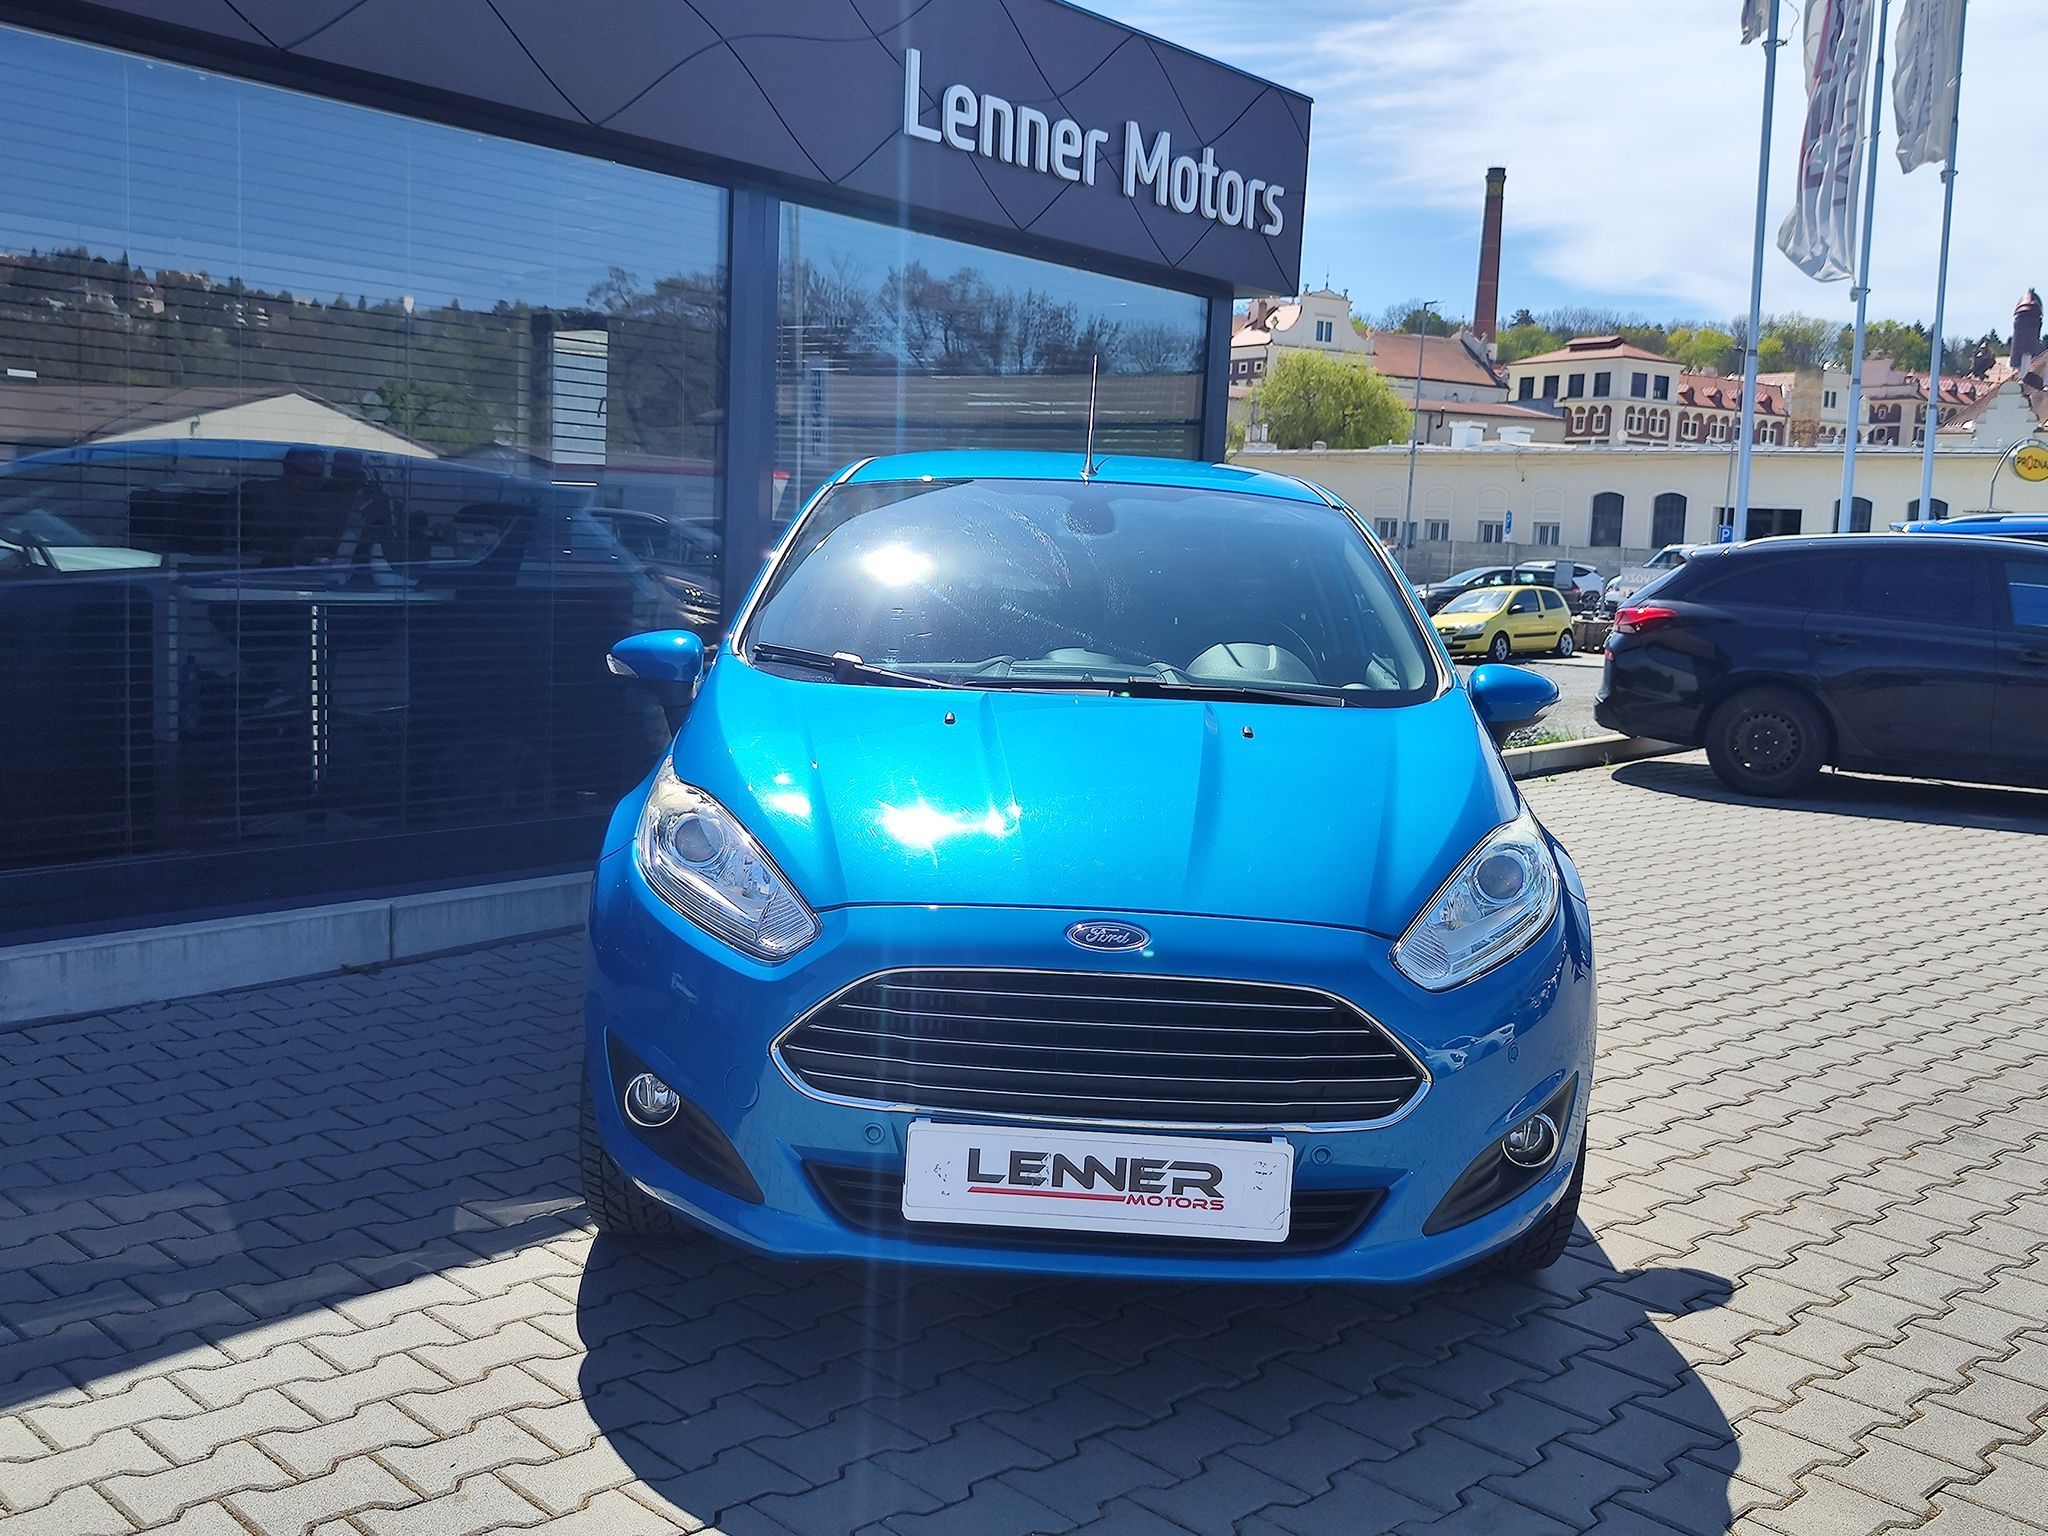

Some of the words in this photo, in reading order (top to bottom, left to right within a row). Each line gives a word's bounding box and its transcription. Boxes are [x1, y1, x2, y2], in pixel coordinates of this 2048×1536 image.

[903, 47, 1110, 187] Lenner
[1122, 119, 1286, 237] Motors
[1721, 528, 1730, 542] P
[1085, 926, 1131, 944] Ford
[967, 1147, 1225, 1198] LENNER
[1126, 1193, 1225, 1211] MOTORS
